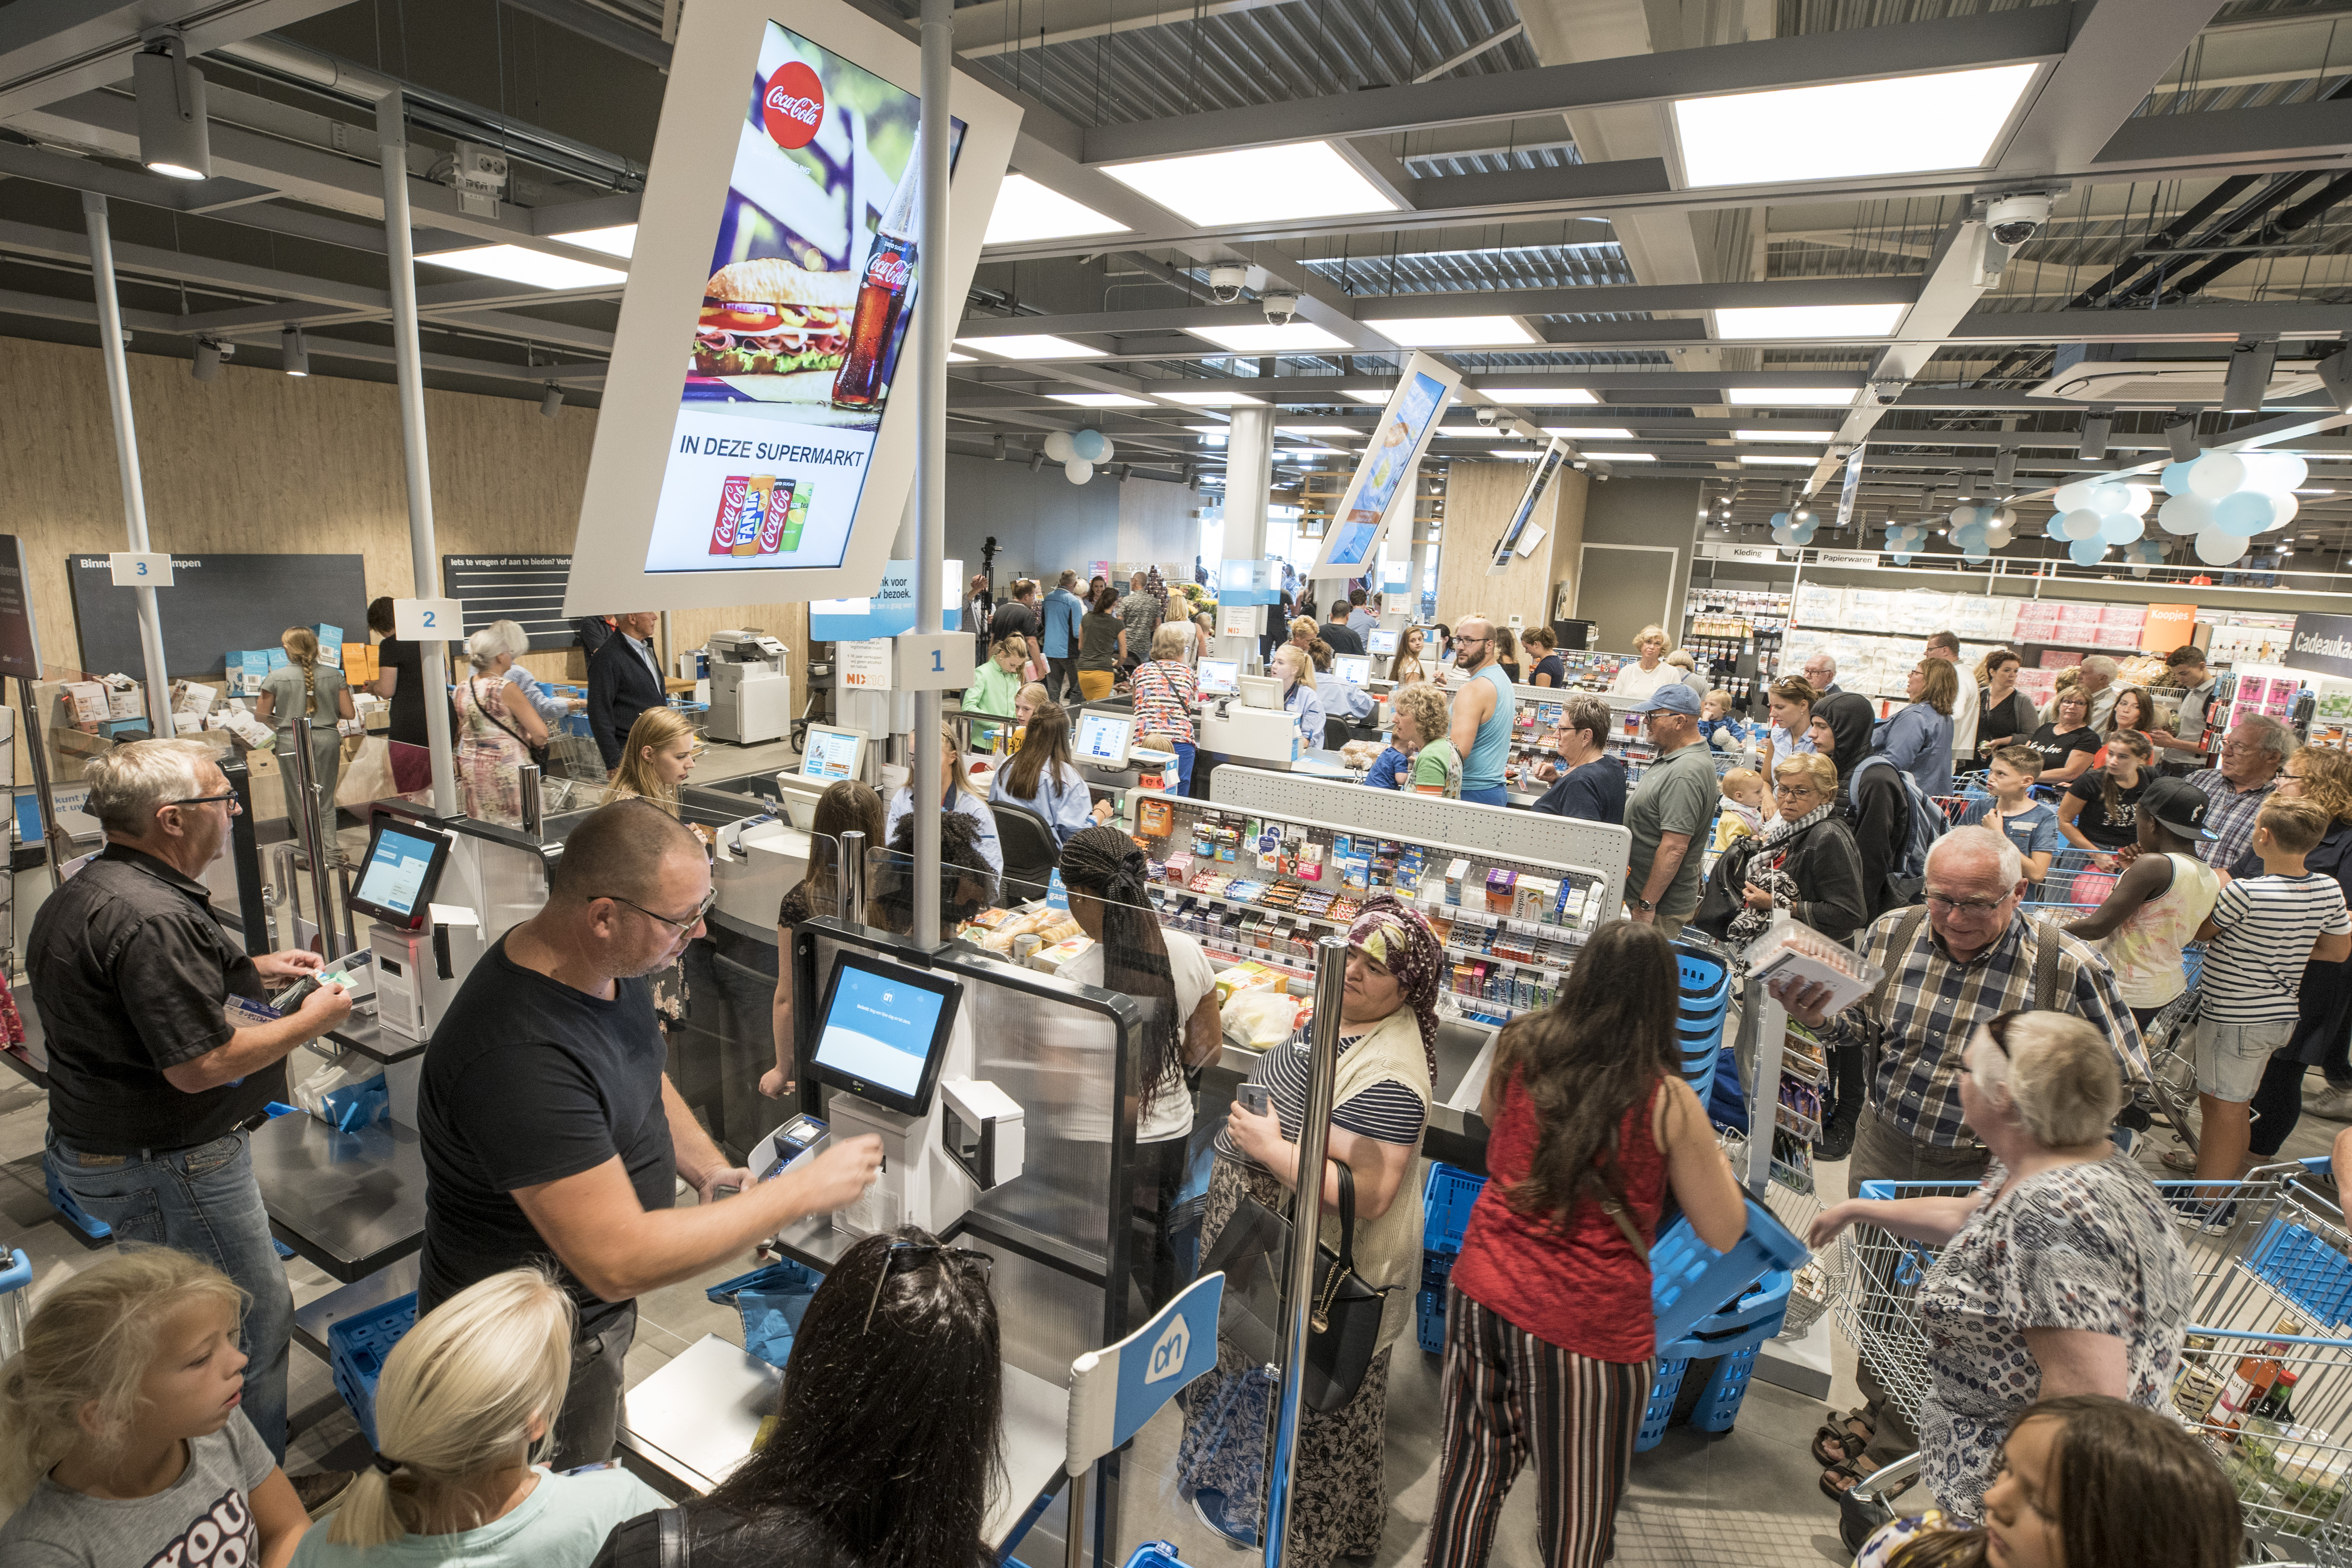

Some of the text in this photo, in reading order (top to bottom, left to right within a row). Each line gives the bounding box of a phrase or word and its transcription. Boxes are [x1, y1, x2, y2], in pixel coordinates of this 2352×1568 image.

[766, 85, 822, 126] Coca-Cola
[865, 252, 913, 286] Coca-Cola
[680, 435, 864, 467] IN DEZE SUPERMARKT
[736, 492, 759, 545] FANTA
[1734, 549, 1762, 558] Kleding
[1823, 554, 1872, 563] Papierwaren
[475, 559, 499, 567] vragen
[530, 557, 555, 565] bieden?
[136, 562, 148, 575] 3
[891, 578, 907, 587] voor
[883, 588, 911, 599] bezoek.
[423, 611, 436, 627] 2
[2151, 609, 2189, 622] Koopjes
[931, 650, 945, 672] 1
[847, 673, 885, 686] NIX18
[2045, 744, 2063, 753] love
[55, 795, 80, 803] kunt
[1048, 893, 1067, 902] gaat
[1304, 892, 1332, 902] SNICKERS
[1297, 904, 1327, 913] SNICKERS
[1515, 889, 1525, 918] Strepsils
